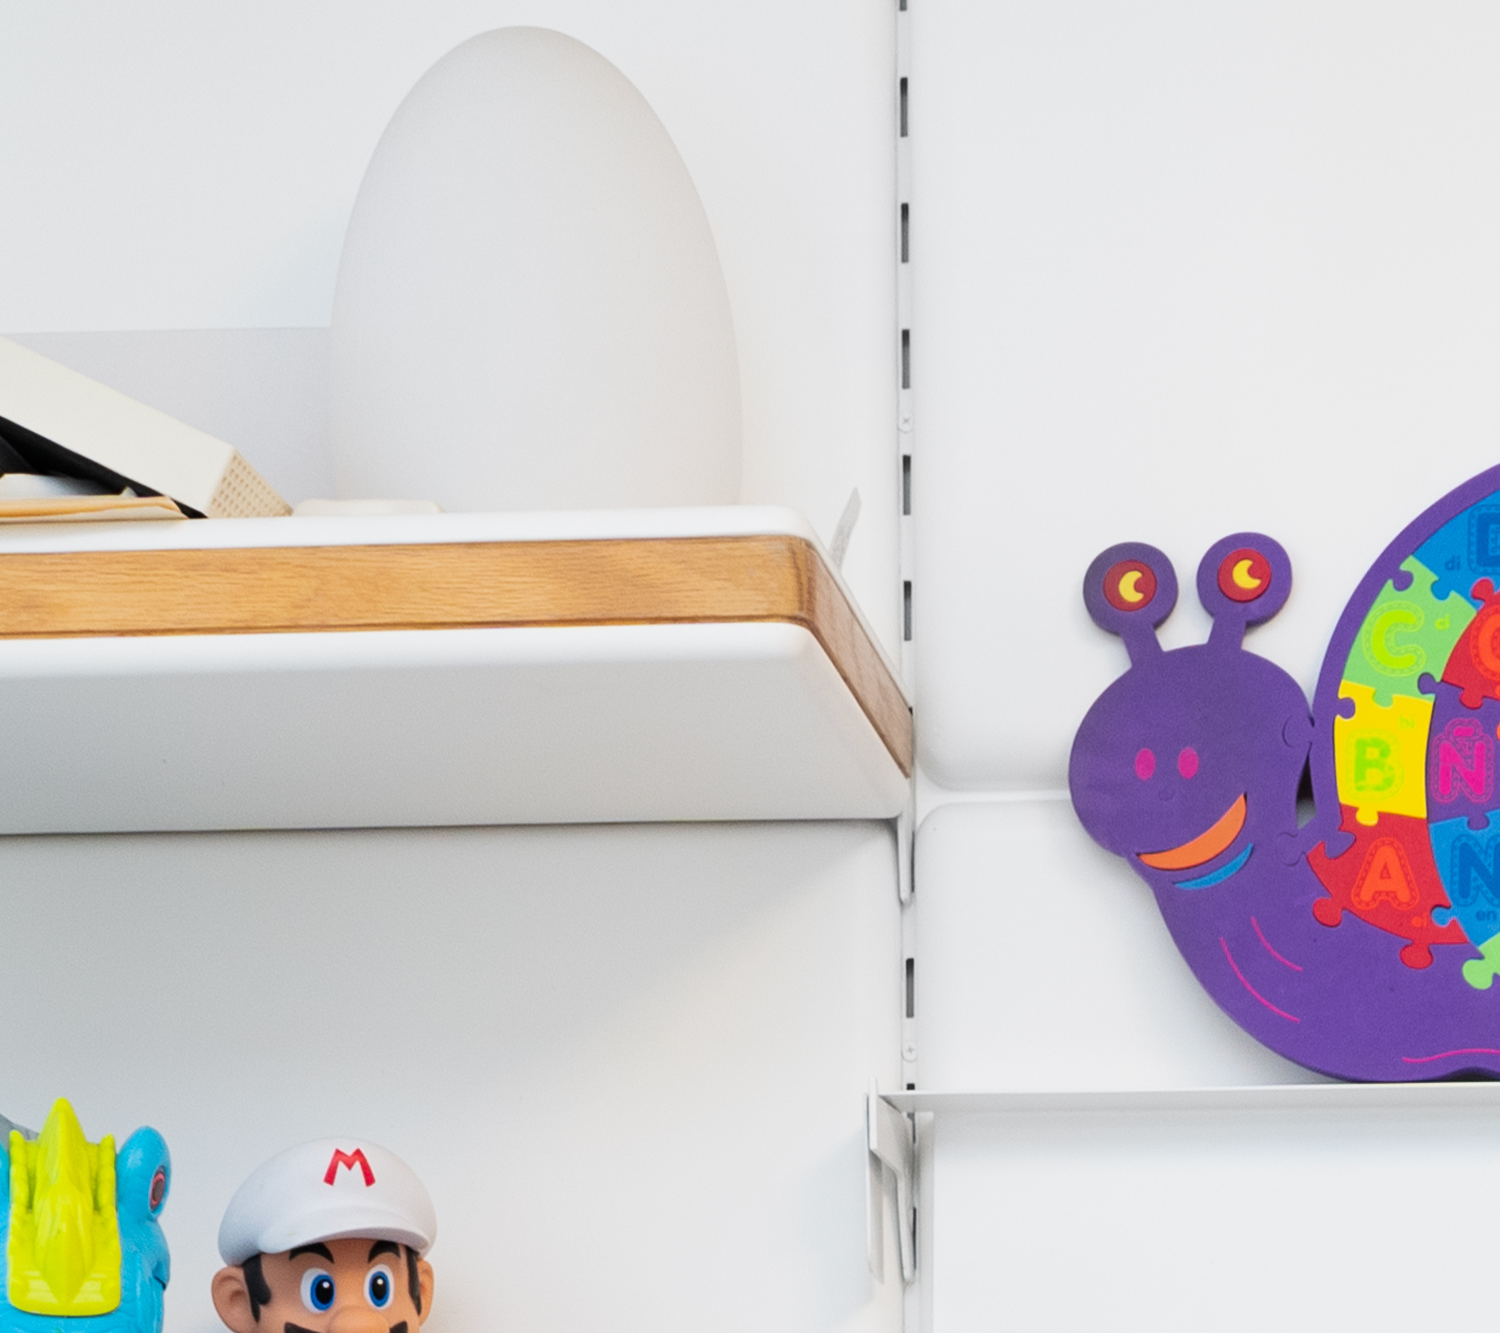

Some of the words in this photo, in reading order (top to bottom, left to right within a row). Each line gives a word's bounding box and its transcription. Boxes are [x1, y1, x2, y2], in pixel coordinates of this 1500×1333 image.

[1368, 606, 1419, 671] C
[1351, 733, 1399, 796] B
[1435, 722, 1489, 799] Ñ
[1356, 842, 1415, 906] A
[1475, 907, 1497, 923] en
[323, 1147, 376, 1187] M
